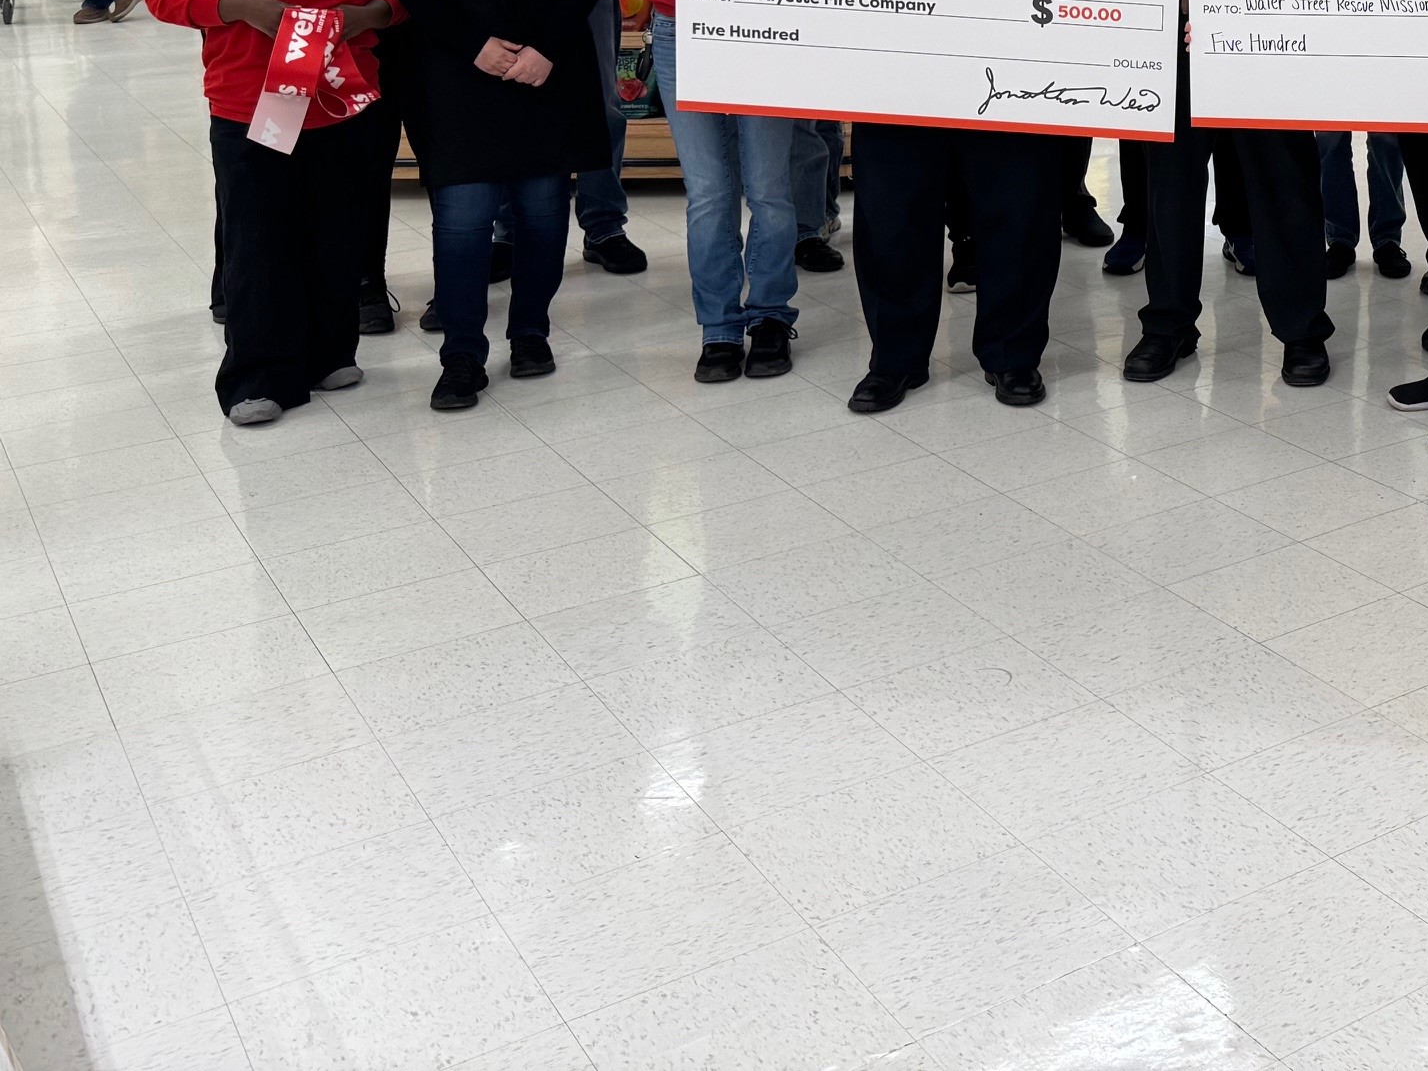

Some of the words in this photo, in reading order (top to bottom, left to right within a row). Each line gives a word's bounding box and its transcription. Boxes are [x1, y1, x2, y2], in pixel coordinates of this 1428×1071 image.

[1203, 4, 1222, 15] PAY
[1223, 4, 1242, 15] TO:
[692, 22, 726, 38] Five
[729, 24, 800, 42] Hundred
[1210, 31, 1244, 53] Five
[1249, 32, 1307, 53] Hundred
[1113, 58, 1163, 71] DOLLARS
